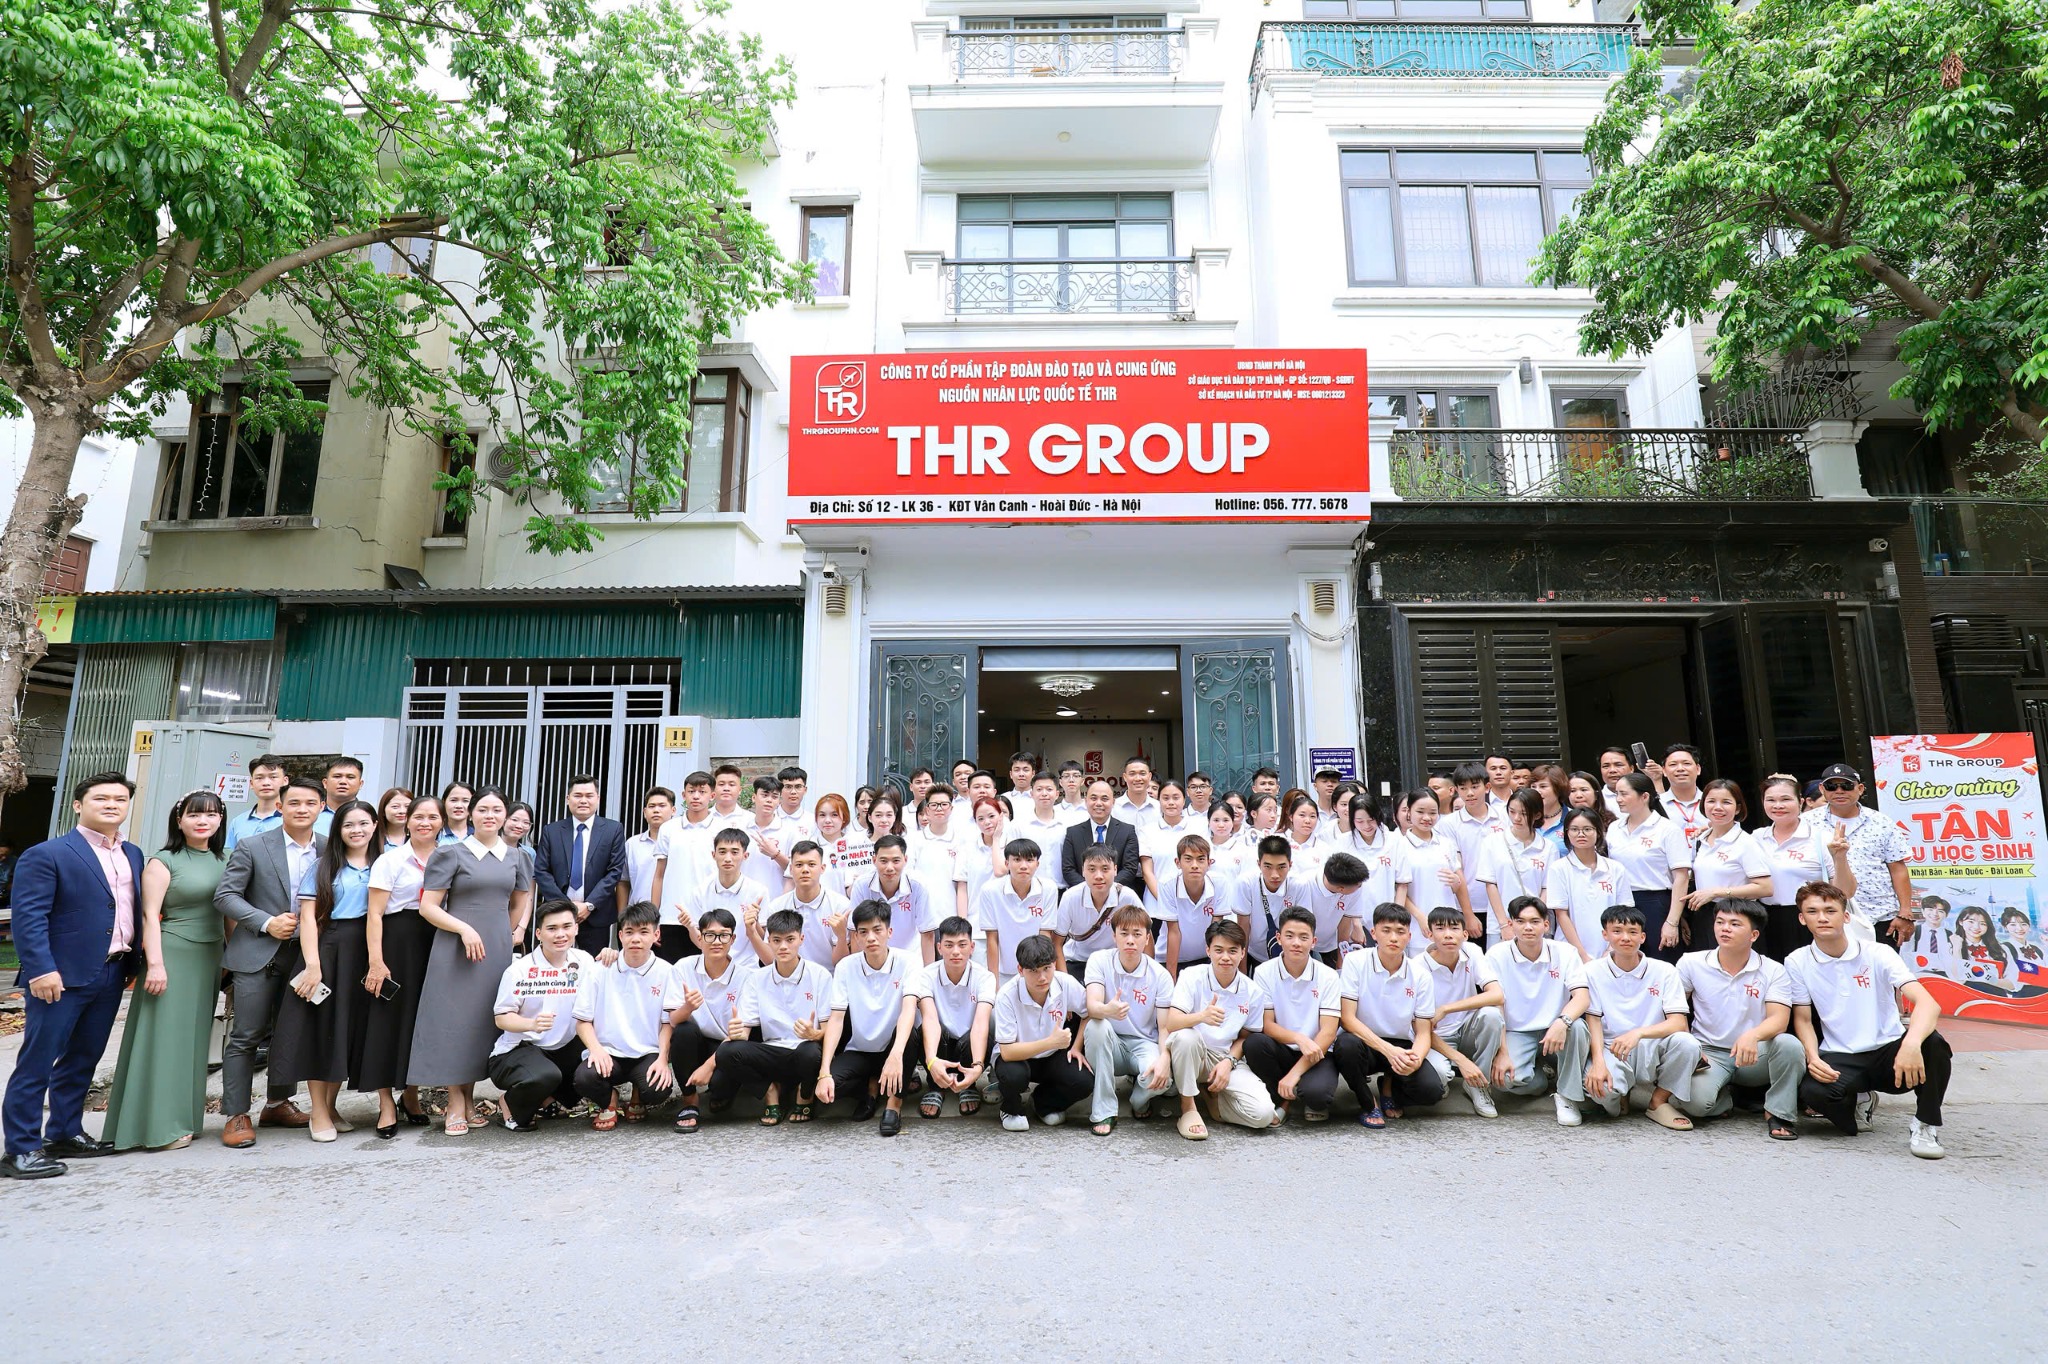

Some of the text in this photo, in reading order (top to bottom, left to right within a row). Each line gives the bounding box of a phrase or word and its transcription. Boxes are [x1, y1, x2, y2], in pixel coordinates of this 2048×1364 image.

[881, 359, 1176, 380] CÔNG TY CỔ PHẦN TẬP ĐOÀN ĐÀO TẠO VÀ CUNG ỨNG
[940, 382, 1116, 404] NGUỒN NHÂN LỰC QUỐC TẾ THR
[888, 423, 1269, 475] THR GROUP
[809, 501, 829, 516] Địa
[832, 499, 855, 513] Chỉ:
[858, 499, 874, 513] Số
[876, 501, 891, 513] 12
[902, 500, 916, 513] LK
[919, 500, 934, 513] 36
[949, 500, 971, 512] KĐT
[974, 499, 996, 512] Vân
[999, 500, 1028, 512] Canh
[1039, 499, 1066, 512] Hoài
[1068, 499, 1091, 512] Đức
[1103, 498, 1118, 511] Hà
[1121, 498, 1141, 514] Nội
[1215, 497, 1348, 511] Hotline: 056. 777. 5678
[674, 731, 686, 740] 11
[1895, 778, 2020, 801] Chào mừng
[1912, 803, 2011, 840] TÂN
[1932, 845, 1975, 865] HỌC
[1981, 843, 2033, 860] SINH
[1911, 868, 1927, 876] Nhật
[1930, 867, 1942, 876] Bản
[1950, 867, 1963, 875] Hàn
[1965, 866, 1983, 875] Quốc
[1991, 866, 2003, 875] Đài
[2005, 866, 2024, 874] Loan
